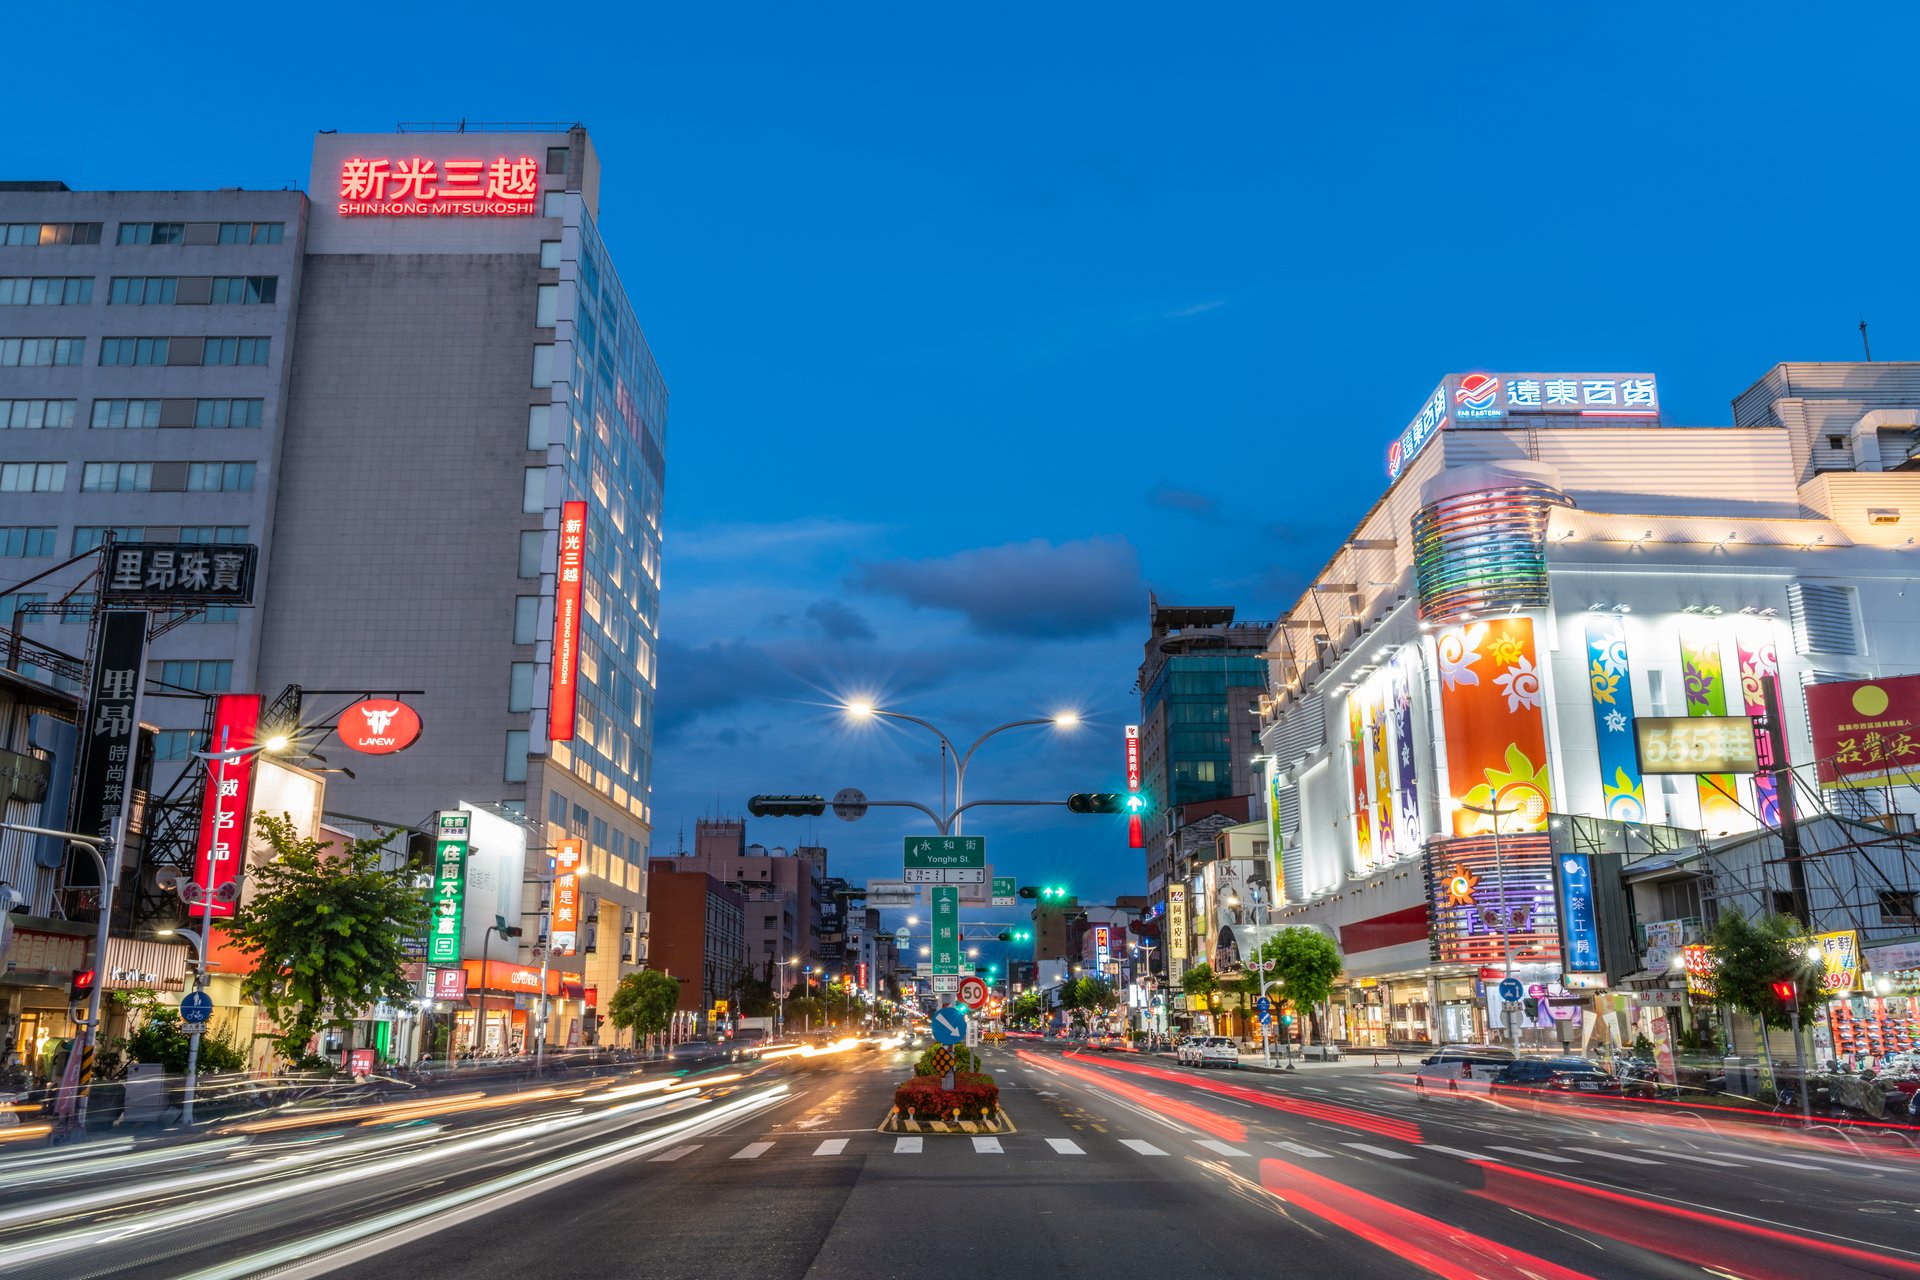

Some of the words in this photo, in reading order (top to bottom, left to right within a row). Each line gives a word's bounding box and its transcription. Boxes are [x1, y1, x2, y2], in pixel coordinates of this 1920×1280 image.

[340, 157, 538, 200] 新光三越
[338, 203, 378, 215] SHIN
[380, 203, 428, 215] KONG
[432, 203, 534, 215] MITSUKOSHI
[1507, 380, 1656, 407] 遠東百貨
[1402, 386, 1446, 461] 遠東百貨
[111, 551, 245, 591] 里昂珠寶
[563, 519, 582, 583] 新光三越
[561, 639, 570, 685] MITSUKOSHI
[94, 668, 135, 738] 里昂
[1646, 727, 1752, 762] 555鞋
[444, 817, 464, 827] 住商
[921, 840, 976, 850] 永和街
[927, 855, 958, 864] Yonghe
[959, 855, 971, 863] St.
[438, 845, 461, 934] 住商不動產
[558, 874, 574, 922] 康是美
[940, 904, 951, 963] 垂楊路
[1173, 905, 1183, 948] 阿瘦皮鞋
[444, 973, 456, 986] P
[963, 986, 982, 1000] 50
